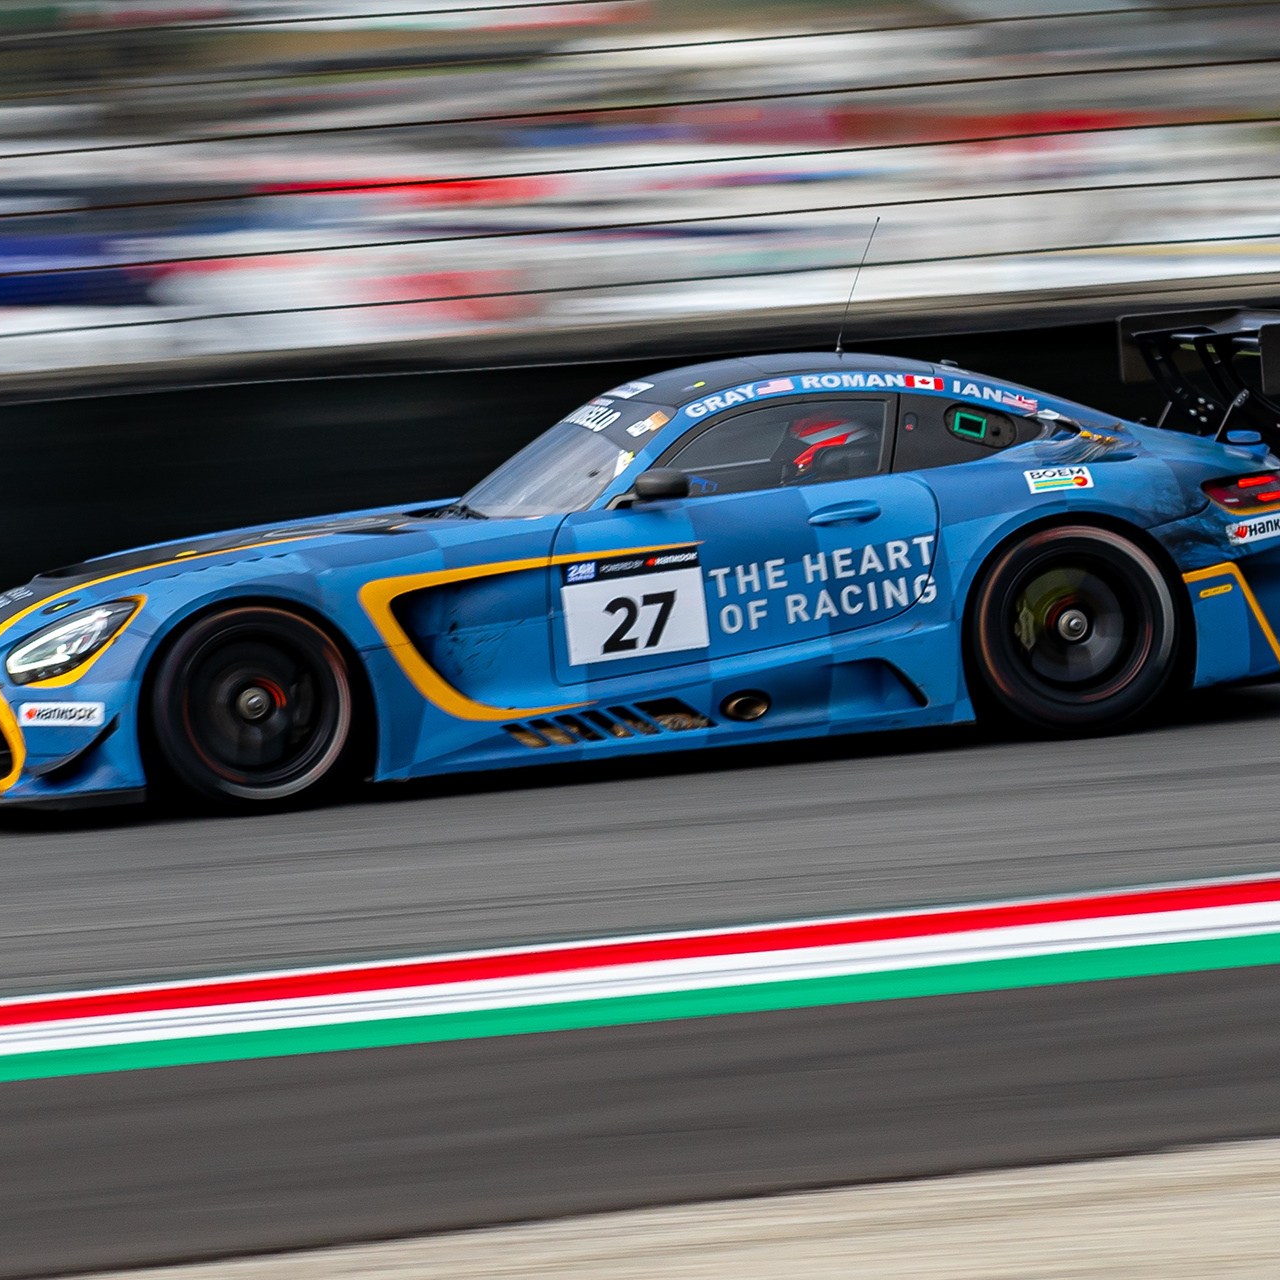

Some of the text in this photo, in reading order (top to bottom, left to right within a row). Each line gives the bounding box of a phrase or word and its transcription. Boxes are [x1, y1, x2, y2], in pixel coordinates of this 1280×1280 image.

[801, 374, 907, 390] ROMAN
[952, 380, 1003, 402] IAN
[684, 384, 758, 419] GRAY
[1029, 468, 1085, 480] BOEM
[708, 535, 935, 599] THE HEART
[719, 573, 938, 635] OF RACING
[601, 589, 678, 655] 27
